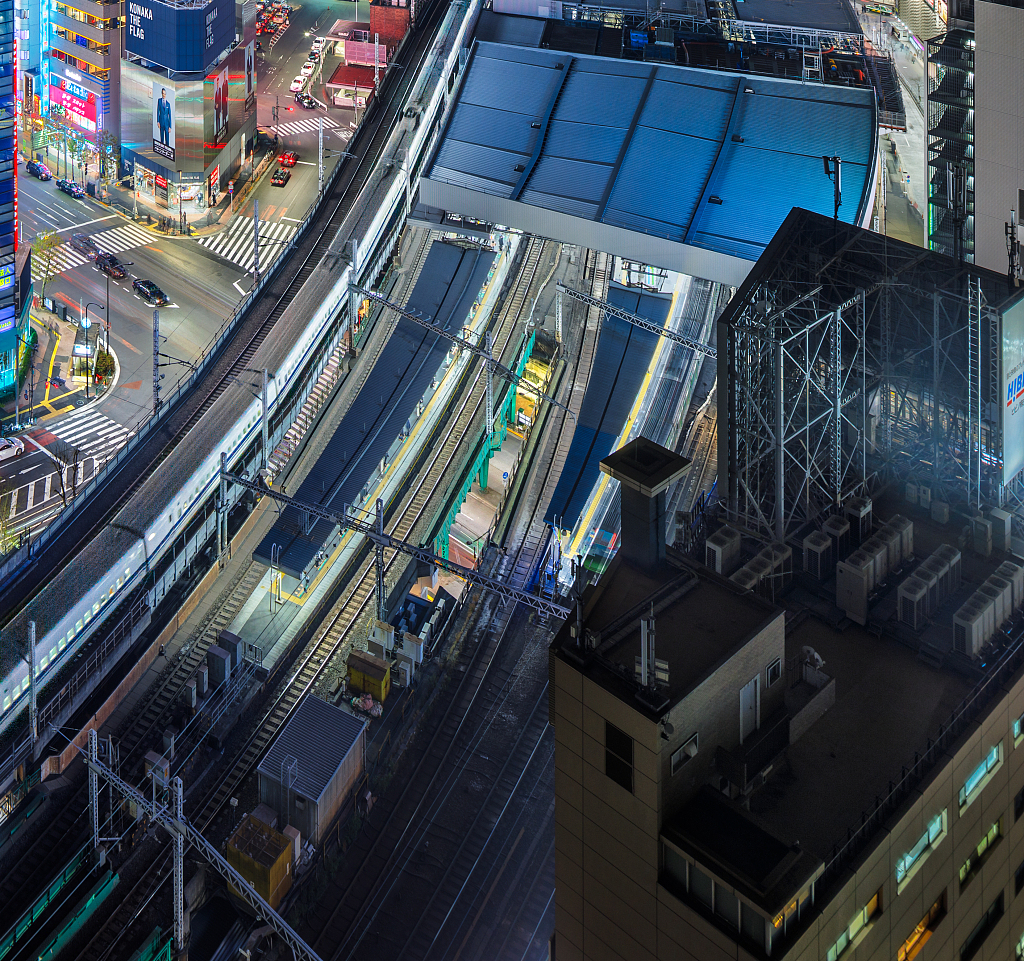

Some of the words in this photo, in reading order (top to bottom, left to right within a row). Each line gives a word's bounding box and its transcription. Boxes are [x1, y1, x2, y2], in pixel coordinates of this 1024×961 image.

[129, 2, 153, 20] KONAKA
[129, 13, 141, 27] THE
[129, 25, 145, 40] FLAG
